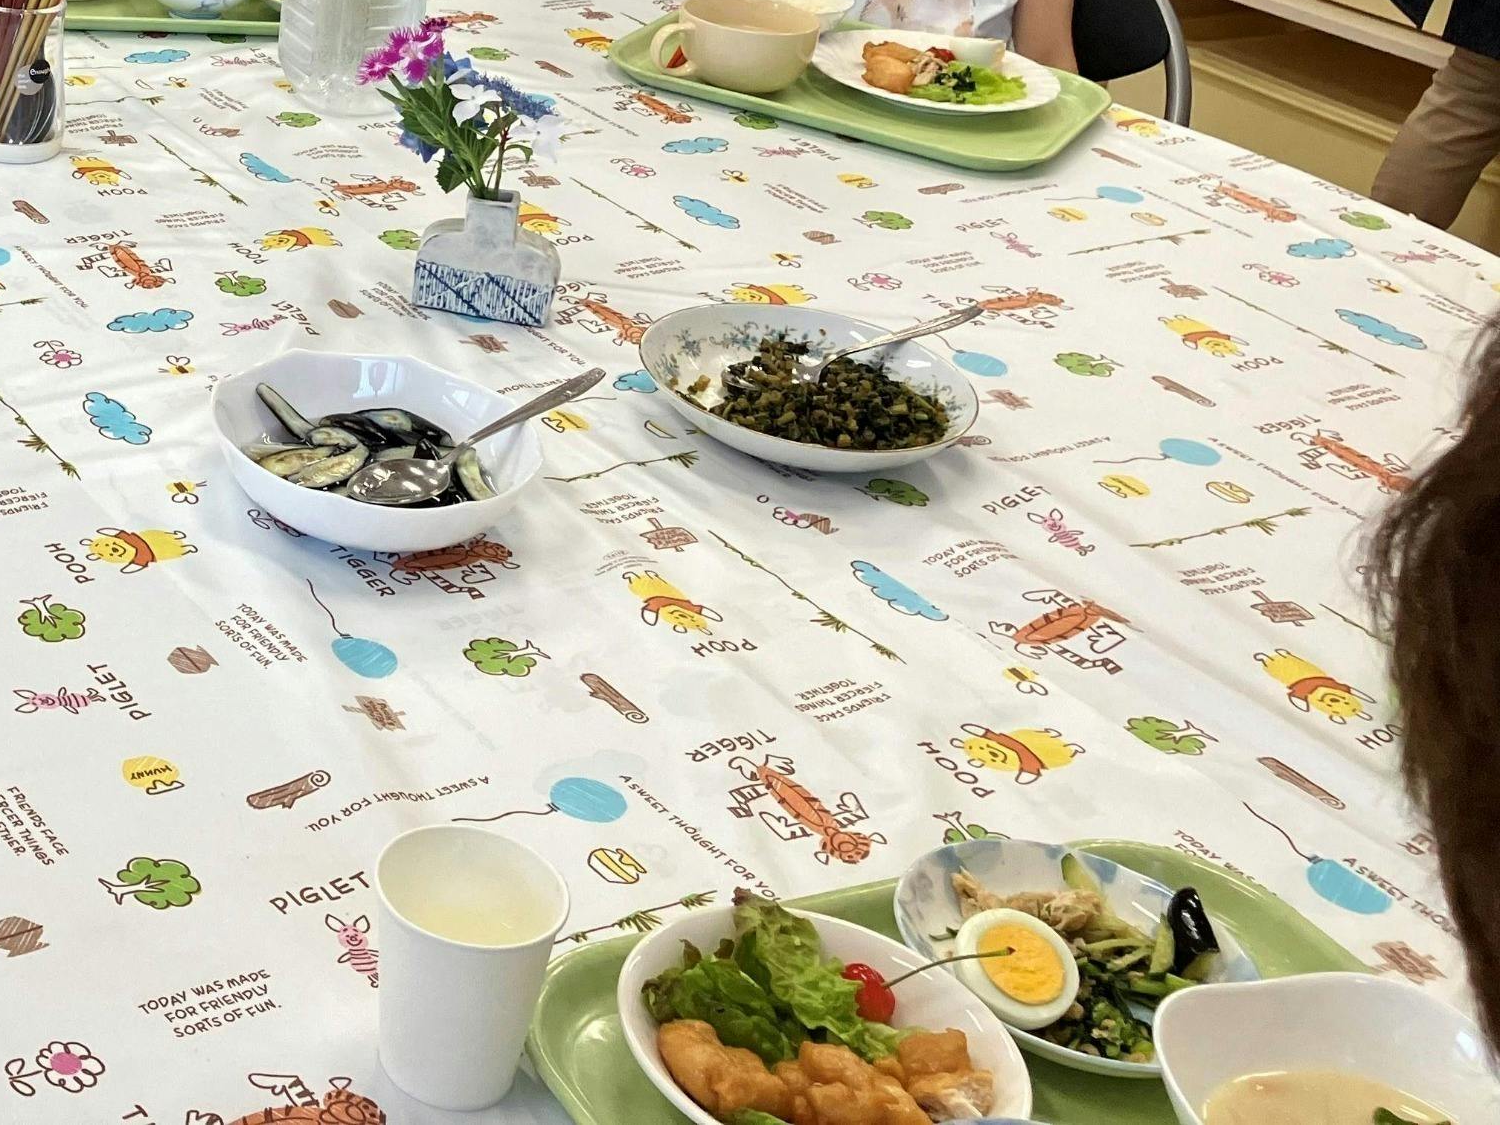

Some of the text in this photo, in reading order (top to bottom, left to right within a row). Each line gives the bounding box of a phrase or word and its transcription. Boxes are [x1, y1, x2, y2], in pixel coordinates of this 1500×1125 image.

[98, 187, 149, 197] POOH
[64, 228, 134, 245] TIGGER
[227, 241, 269, 265] POOH
[556, 233, 595, 246] POO
[271, 300, 321, 336] PIGLET
[1230, 355, 1284, 373] POOH
[1253, 415, 1322, 436] TIGGER
[0, 502, 49, 516] FRIENDS
[981, 485, 1051, 515] PIGLET
[44, 542, 95, 584] POOH
[329, 545, 396, 597] TIGGER
[214, 620, 244, 643] SORTS
[239, 641, 258, 652] OF
[230, 615, 290, 661] FOR FRIENDLY
[236, 603, 308, 663] TODAY WAS MADE
[690, 638, 758, 657] POOH
[86, 663, 152, 721] PIGLET
[685, 729, 777, 763] TIGGER
[1356, 724, 1403, 750] OOH
[916, 741, 996, 798] POOH
[6, 786, 70, 856] FRIENDS FACE
[305, 776, 490, 832] A SWEET THOUGHT FOR YOU.
[618, 774, 633, 783] A
[628, 782, 670, 815] SWEET
[669, 815, 728, 859] THOUGHT
[723, 859, 756, 881] FOR
[18, 827, 55, 866] THINGS
[1342, 856, 1358, 867] A
[268, 871, 370, 915] PIGLET
[137, 969, 271, 1015] TODAY WAS MADE
[163, 983, 268, 1024] FOR FRIENDLY
[172, 1000, 282, 1038] SORTS OF FUN.
